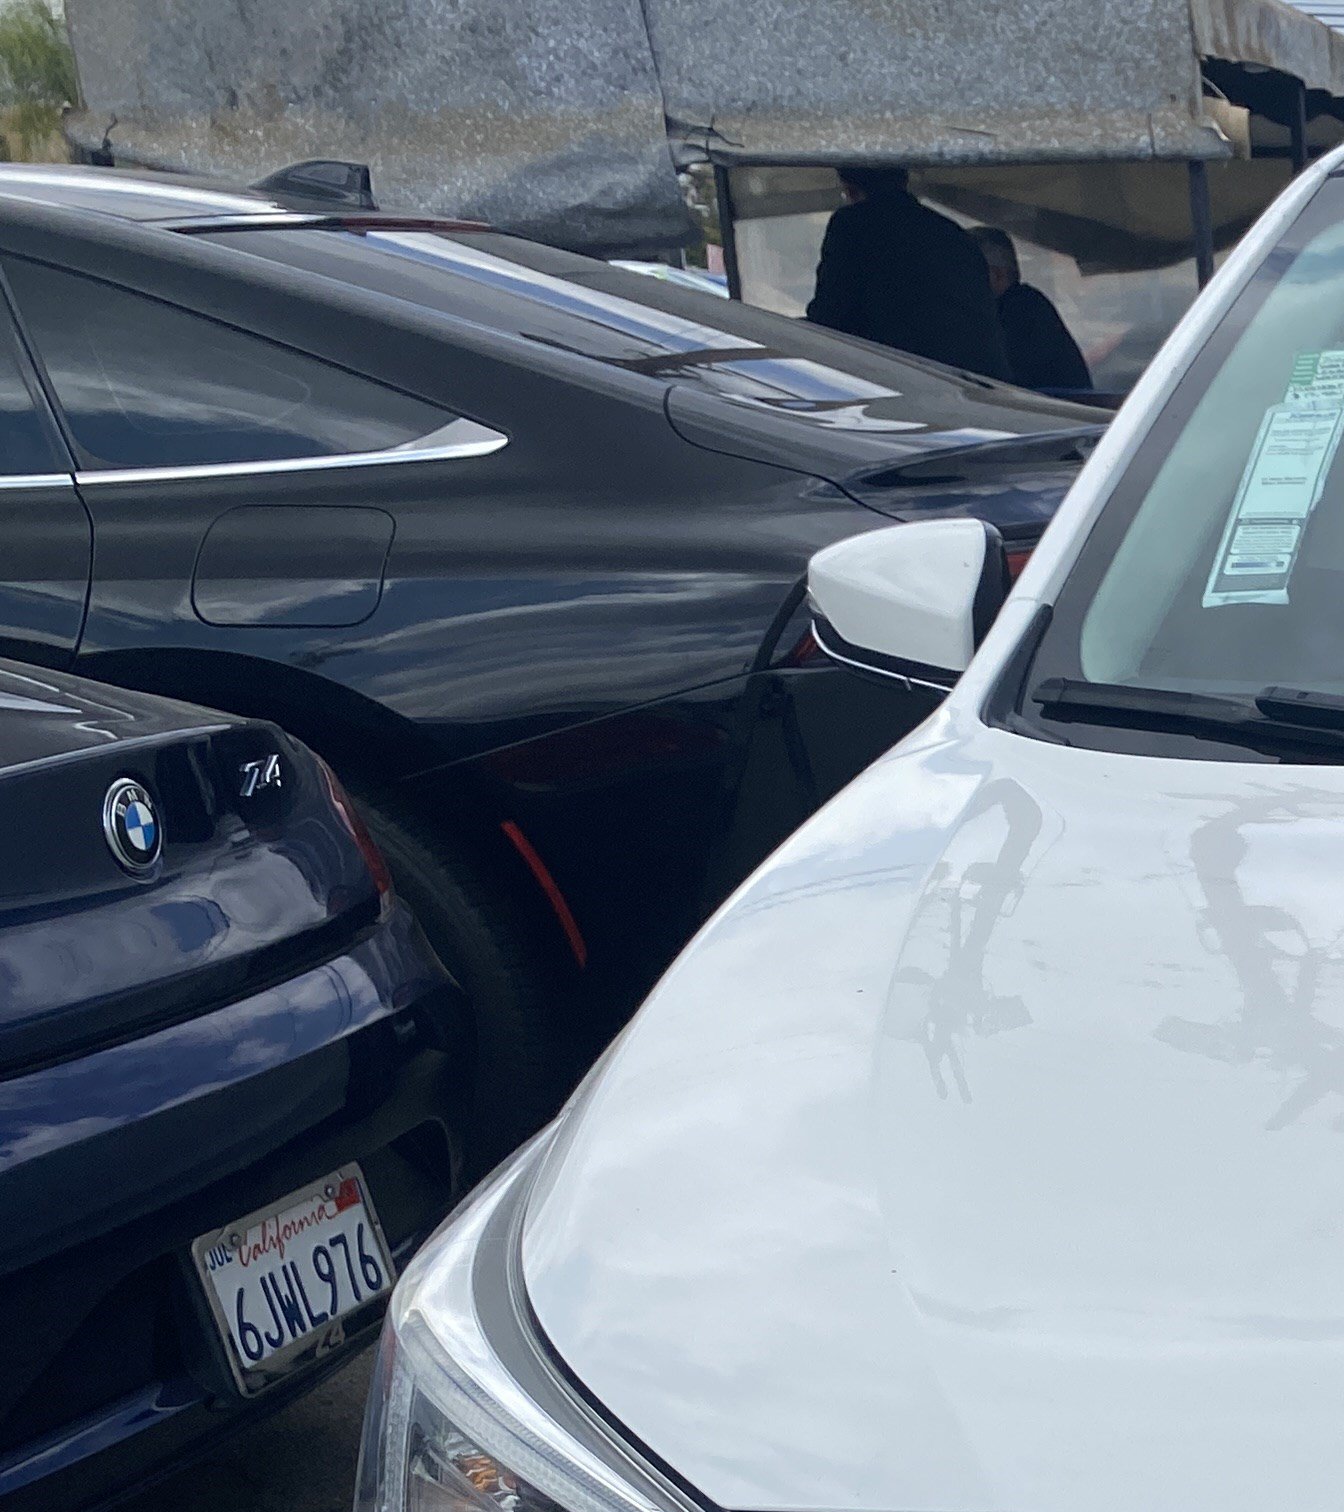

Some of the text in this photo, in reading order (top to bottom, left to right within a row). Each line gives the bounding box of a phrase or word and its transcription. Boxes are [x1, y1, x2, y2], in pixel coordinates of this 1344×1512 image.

[115, 788, 153, 817] BMW
[207, 1243, 233, 1271] JUL
[237, 1202, 341, 1267] California
[236, 1222, 383, 1361] 6JWL976
